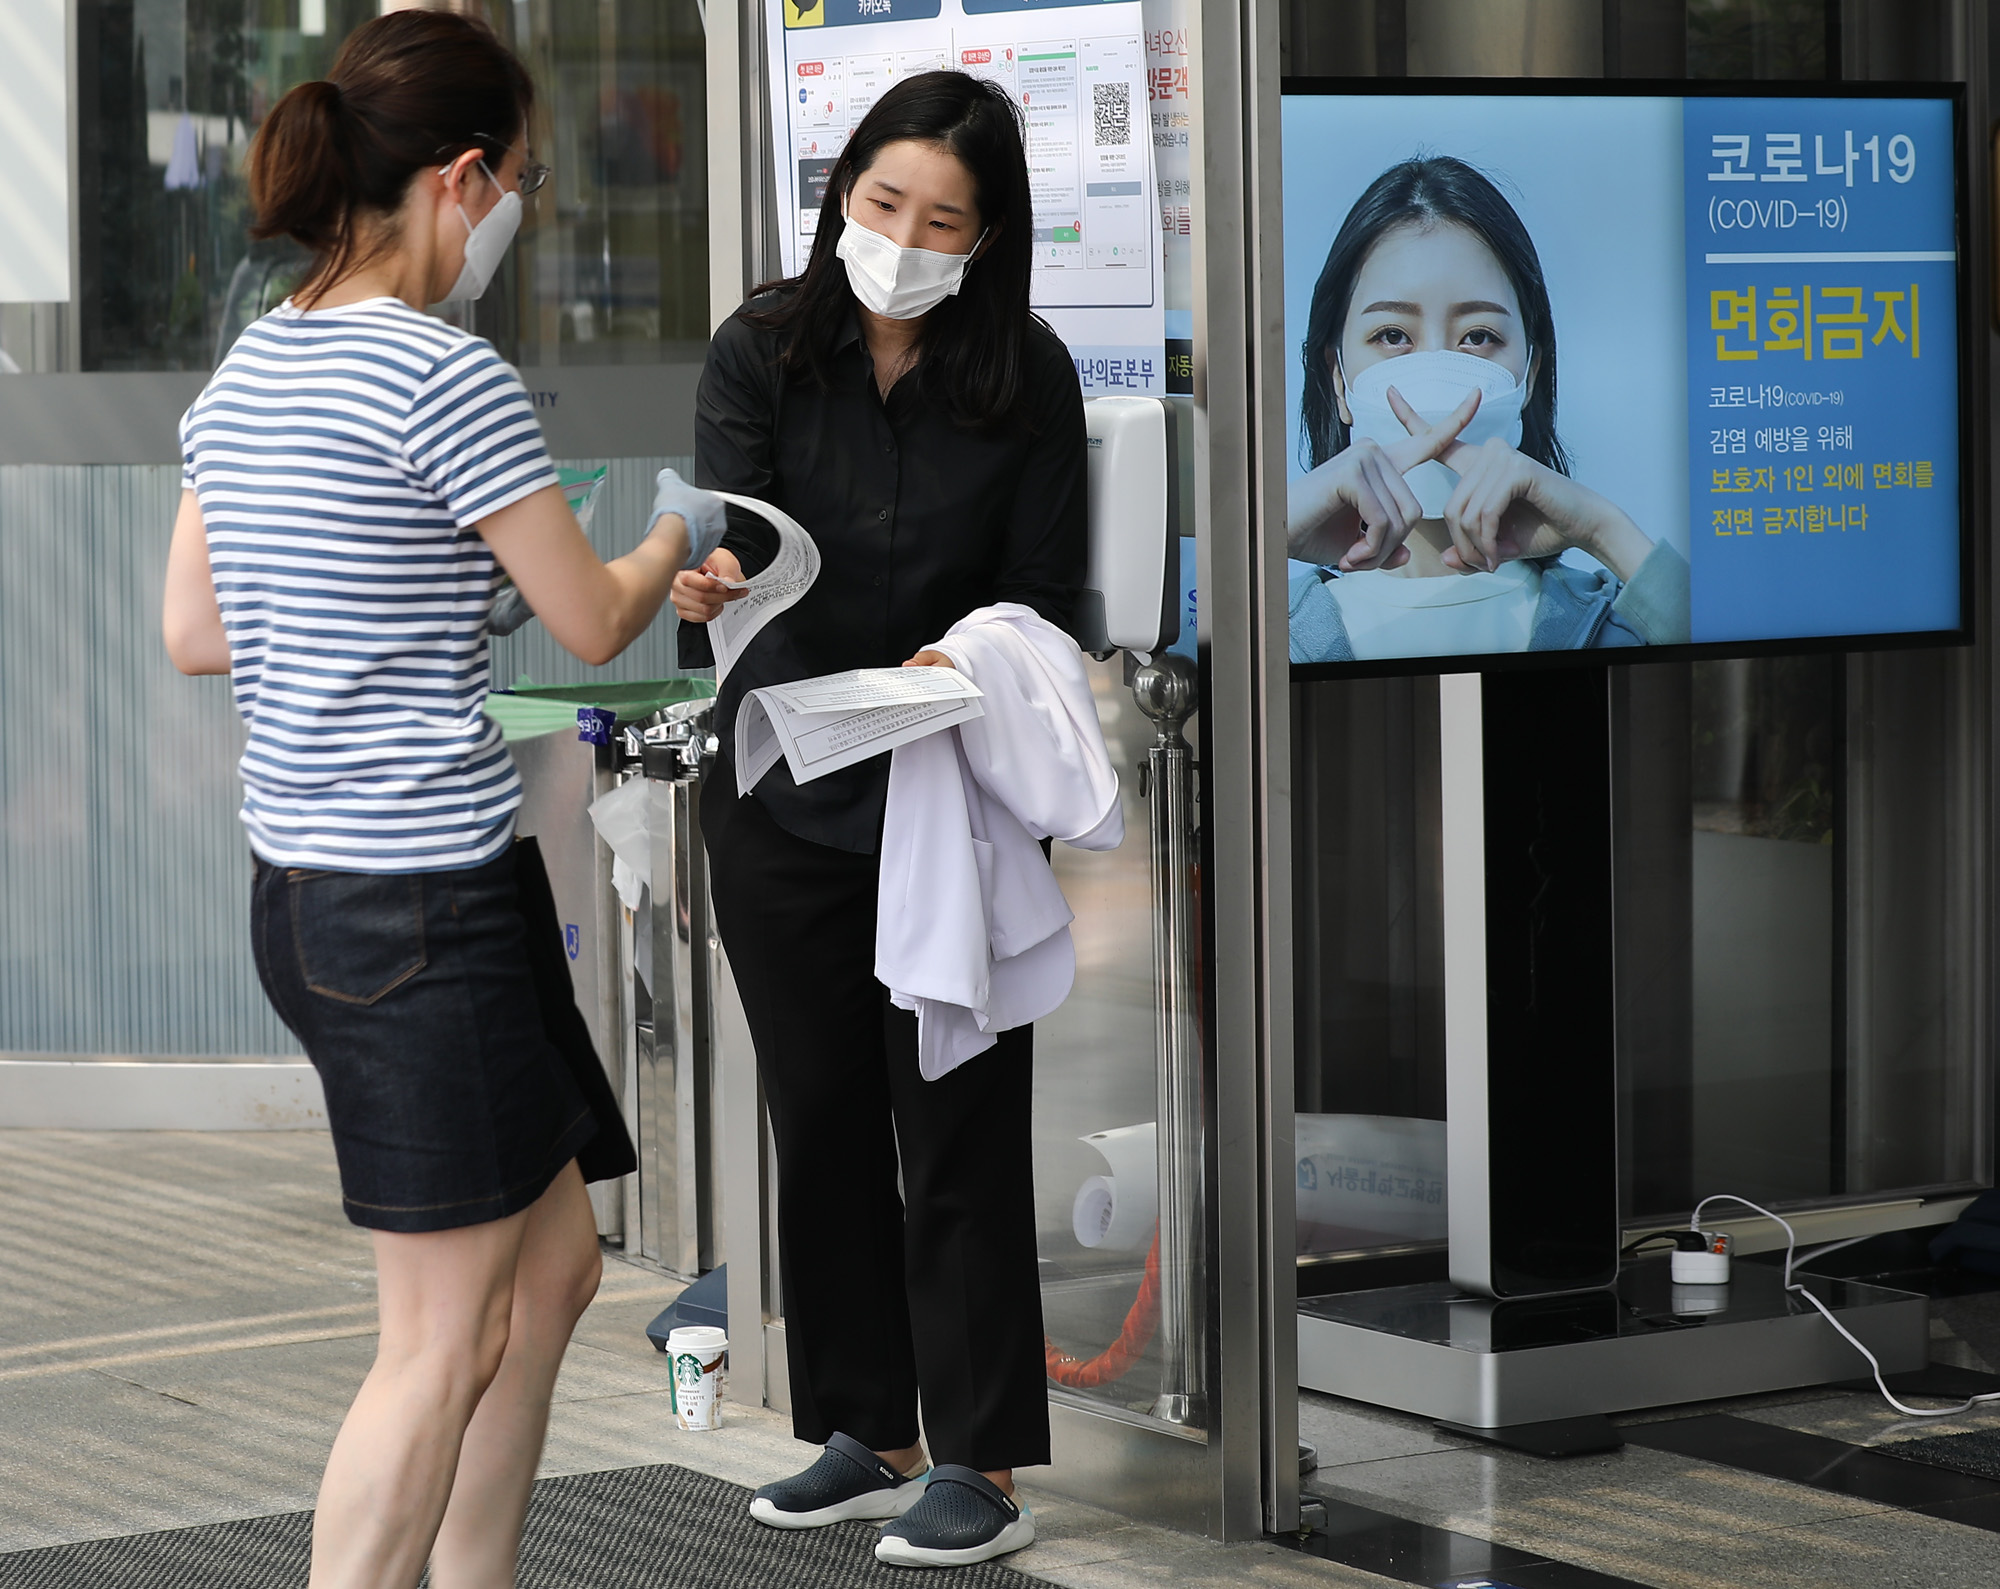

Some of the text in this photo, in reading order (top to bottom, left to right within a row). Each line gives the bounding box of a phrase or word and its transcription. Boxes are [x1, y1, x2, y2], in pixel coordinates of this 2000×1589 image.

[1145, 28, 1188, 57] 녀오신
[1153, 132, 1188, 148] 하겠습니다
[1708, 130, 1915, 187] 코로나19
[1708, 195, 1848, 234] (COVID-19)
[1710, 284, 1920, 361] 면회금지
[1168, 355, 1194, 378] 자동
[1710, 425, 1853, 454] 감염 예방을 위해
[1710, 461, 1935, 494] 보호자 1인 외에 면회를
[1711, 503, 1869, 537] 전면 금지합니다
